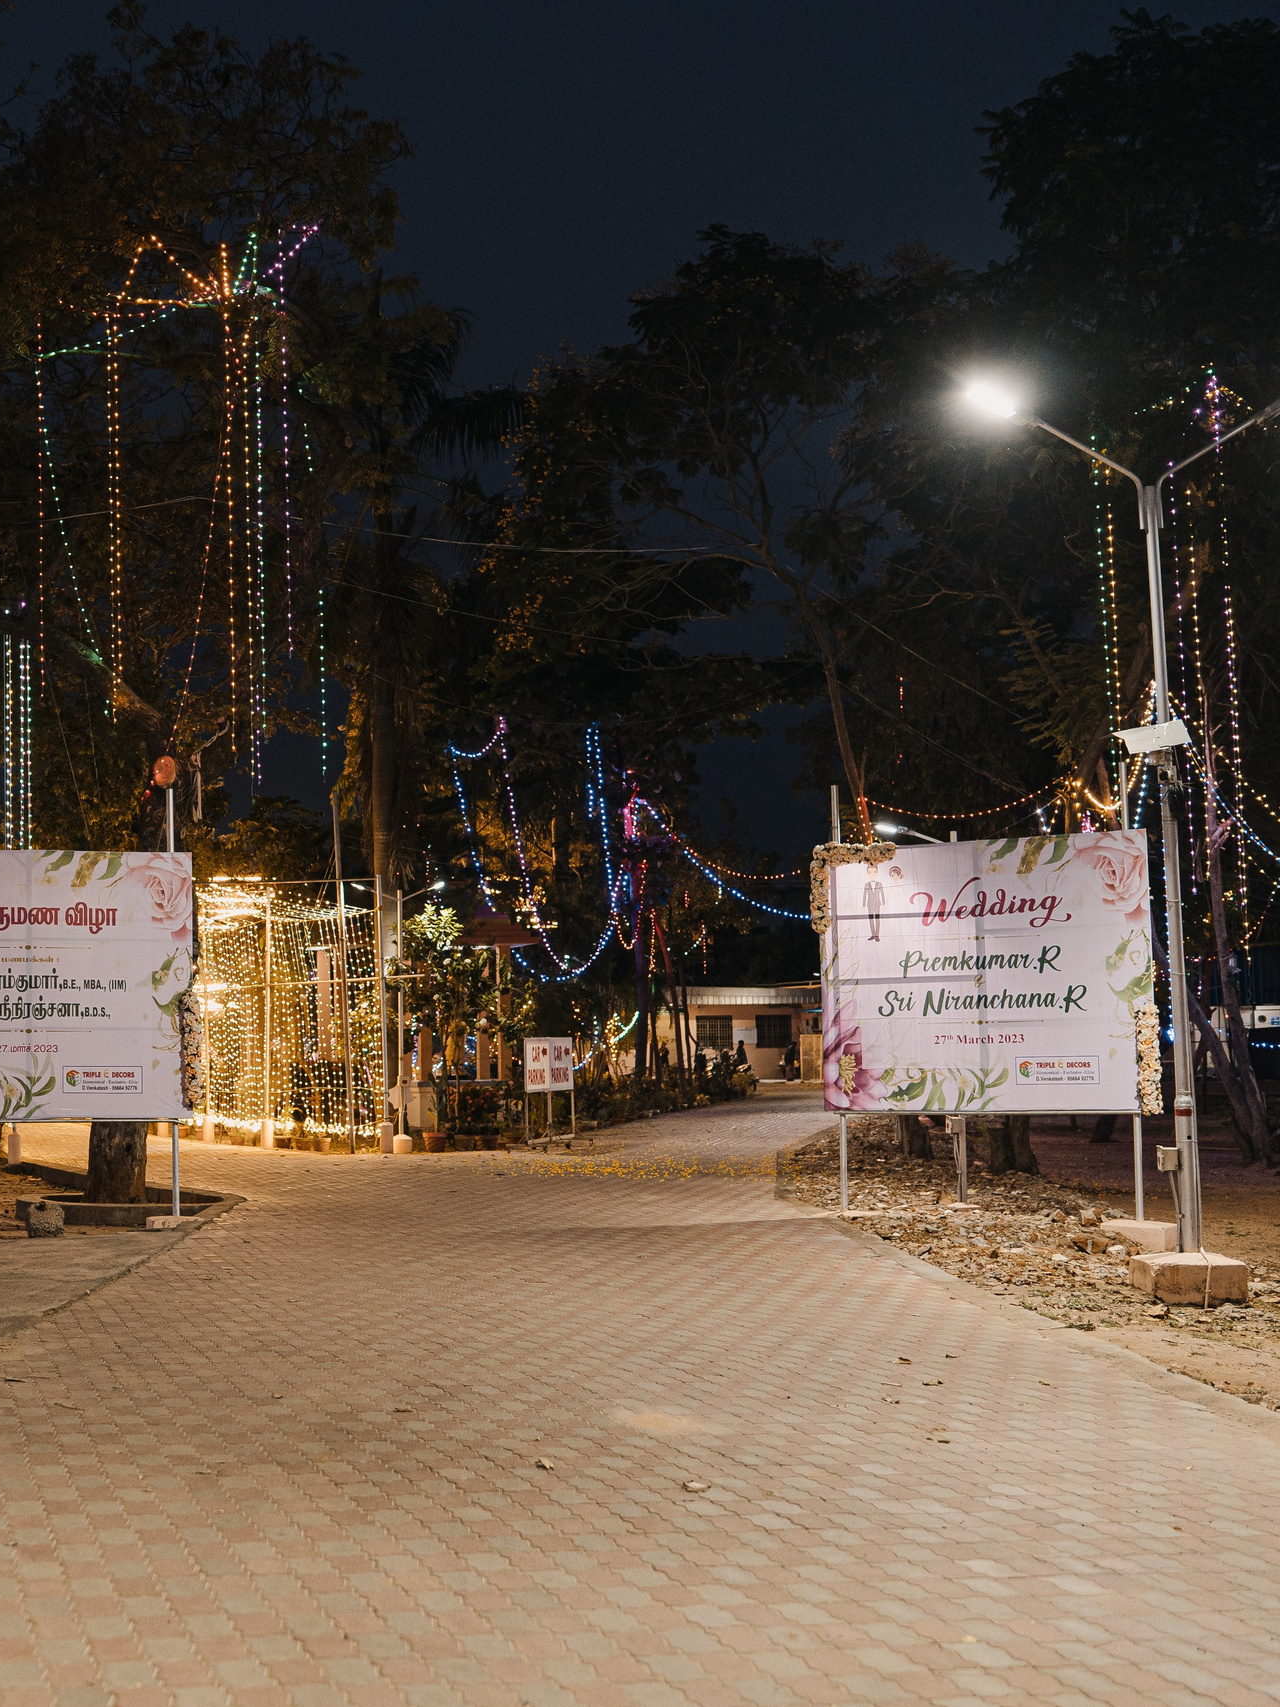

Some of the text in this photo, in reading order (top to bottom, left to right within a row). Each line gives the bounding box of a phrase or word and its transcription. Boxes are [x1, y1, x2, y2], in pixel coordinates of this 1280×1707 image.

[909, 876, 1072, 928] Wedding
[65, 901, 118, 935] விழா
[899, 945, 1062, 979] Premkumar.R
[878, 984, 1088, 1017] Sri Niranchana.R
[956, 1034, 994, 1045] March
[998, 1033, 1025, 1044] 2023
[10, 1043, 31, 1053] மார்ச்
[33, 1044, 59, 1053] 2023
[532, 1046, 541, 1062] CAR
[554, 1045, 562, 1061] CAR
[528, 1069, 545, 1085] PARKING
[551, 1066, 569, 1083] PARKING
